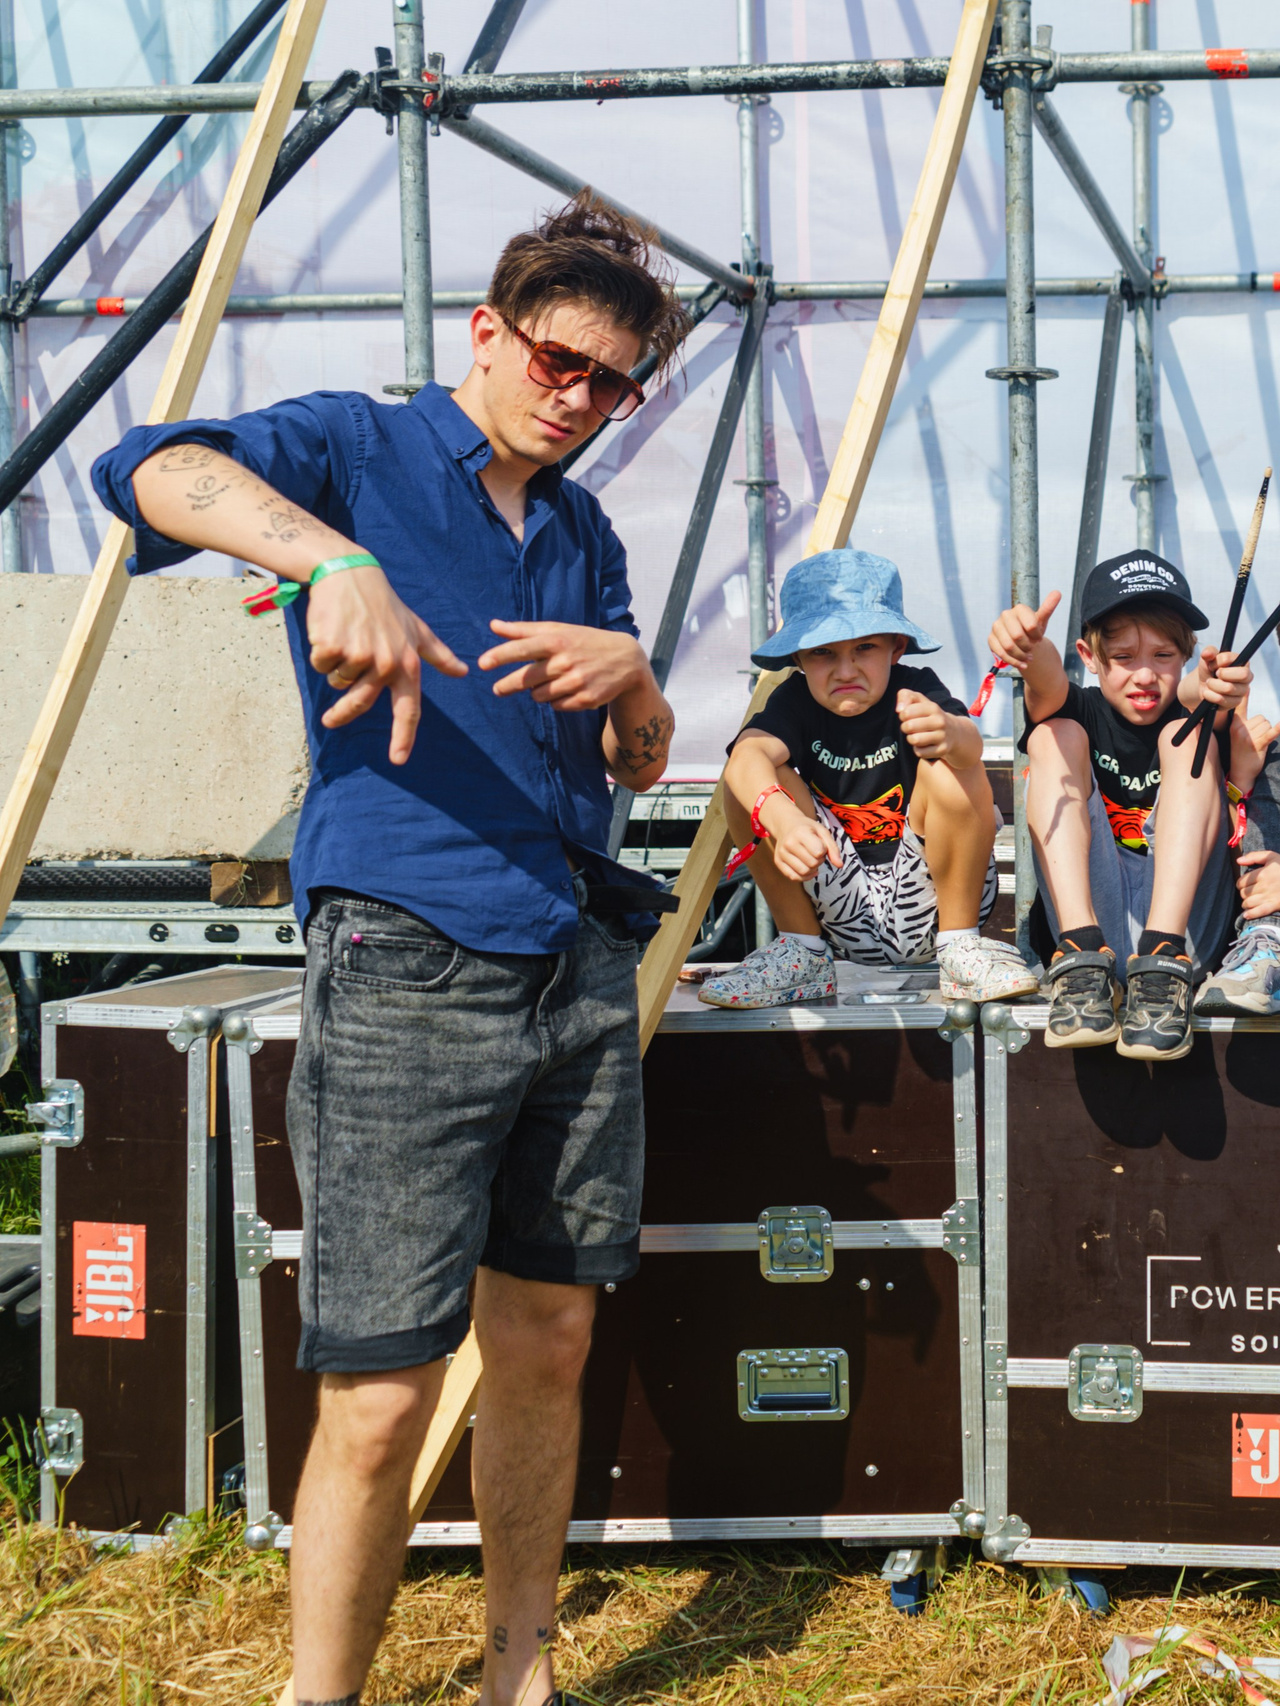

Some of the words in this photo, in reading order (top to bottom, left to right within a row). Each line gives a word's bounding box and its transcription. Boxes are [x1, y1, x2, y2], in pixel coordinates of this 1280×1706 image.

[1109, 559, 1156, 581] DENIM
[1157, 566, 1177, 586] CO.
[1156, 960, 1187, 974] RUNNING
[86, 1235, 134, 1323] JBL
